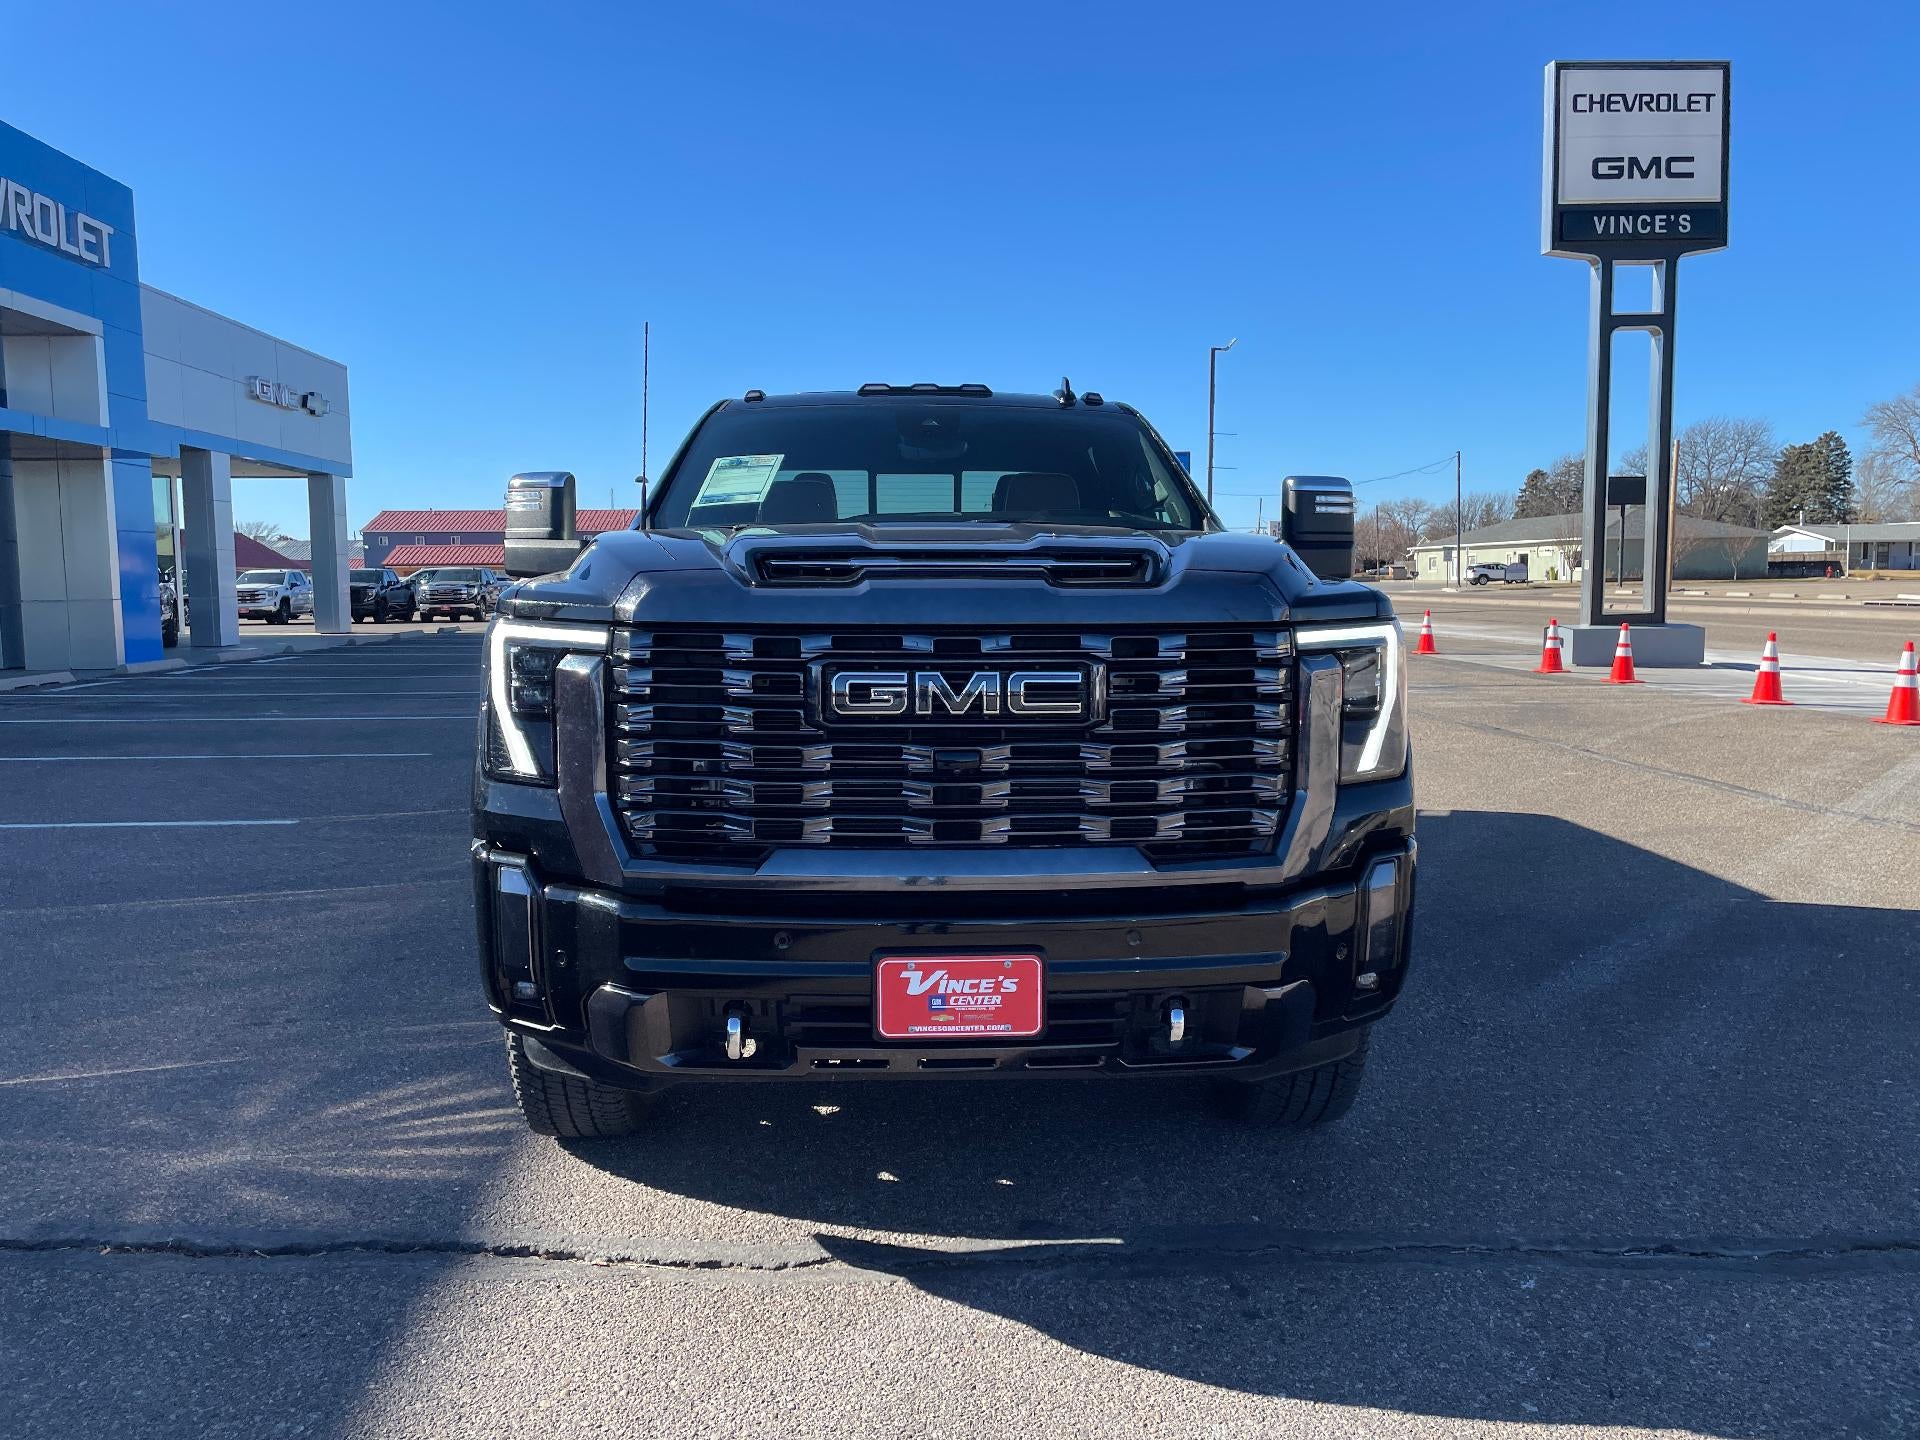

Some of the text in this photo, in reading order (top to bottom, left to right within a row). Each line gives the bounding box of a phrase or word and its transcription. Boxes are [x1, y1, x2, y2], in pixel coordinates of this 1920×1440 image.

[1572, 93, 1716, 113] CHEVROLET
[1591, 156, 1695, 180] GMC
[1593, 214, 1692, 235] VINCE'S
[832, 671, 1083, 715] GMC
[949, 995, 1002, 1006] CENTER
